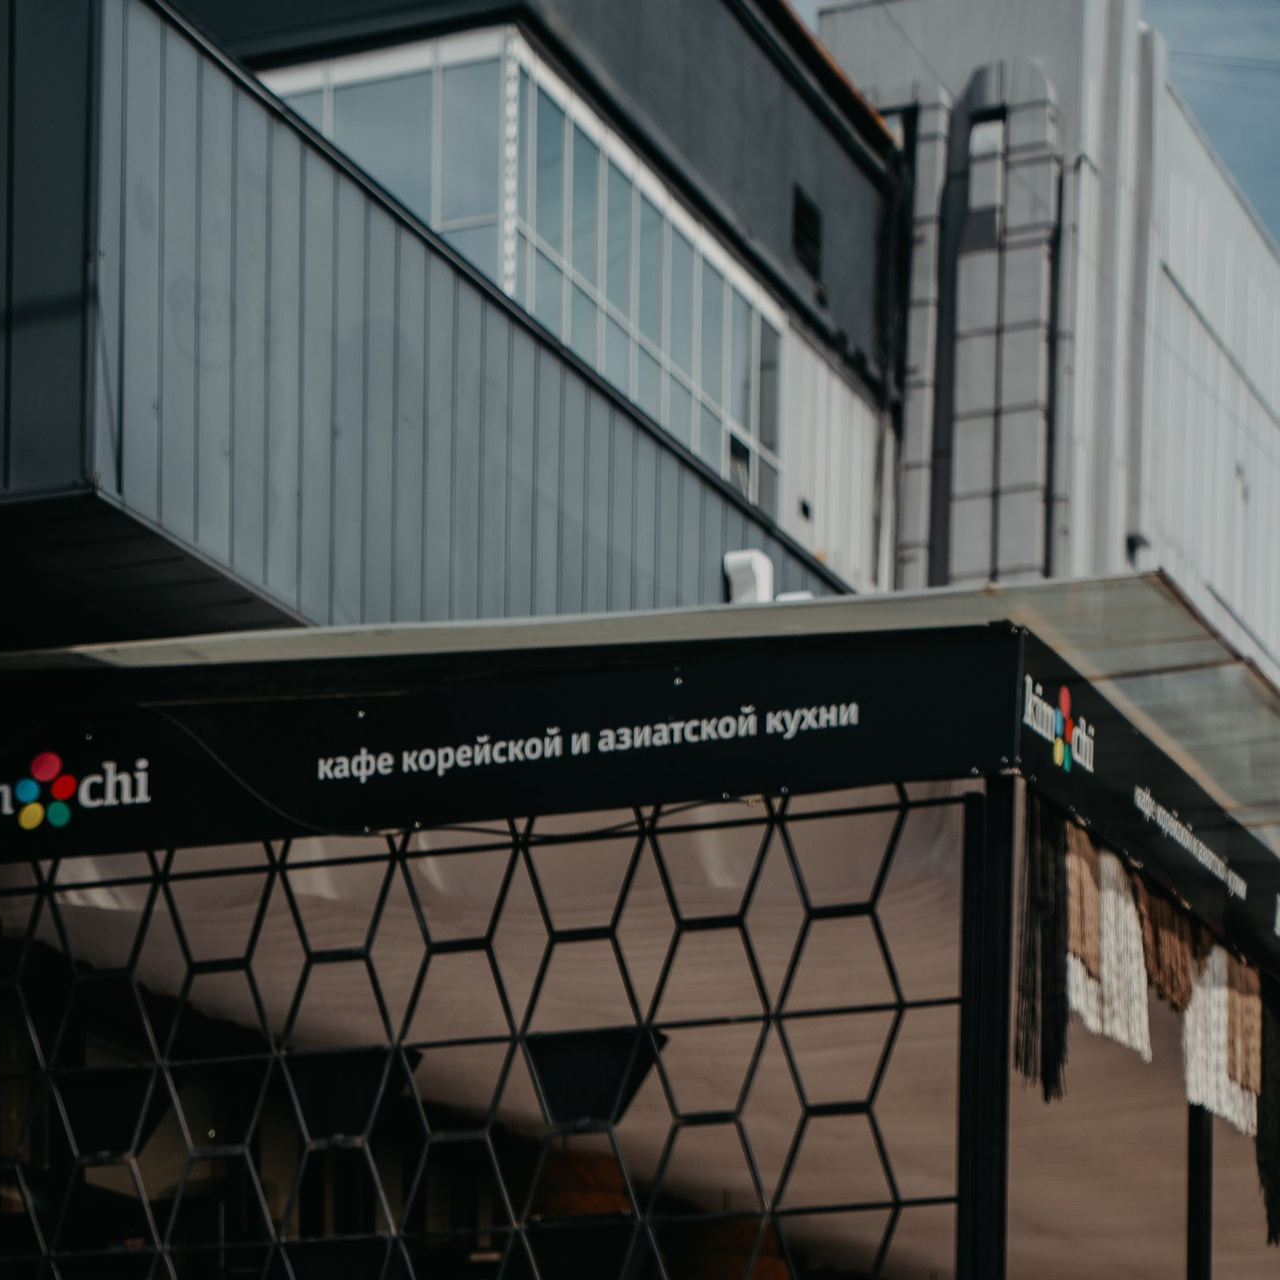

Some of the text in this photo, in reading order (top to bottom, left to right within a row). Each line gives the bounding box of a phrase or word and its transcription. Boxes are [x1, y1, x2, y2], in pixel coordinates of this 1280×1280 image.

[317, 701, 860, 784] кафе корейской и азиатской кухни
